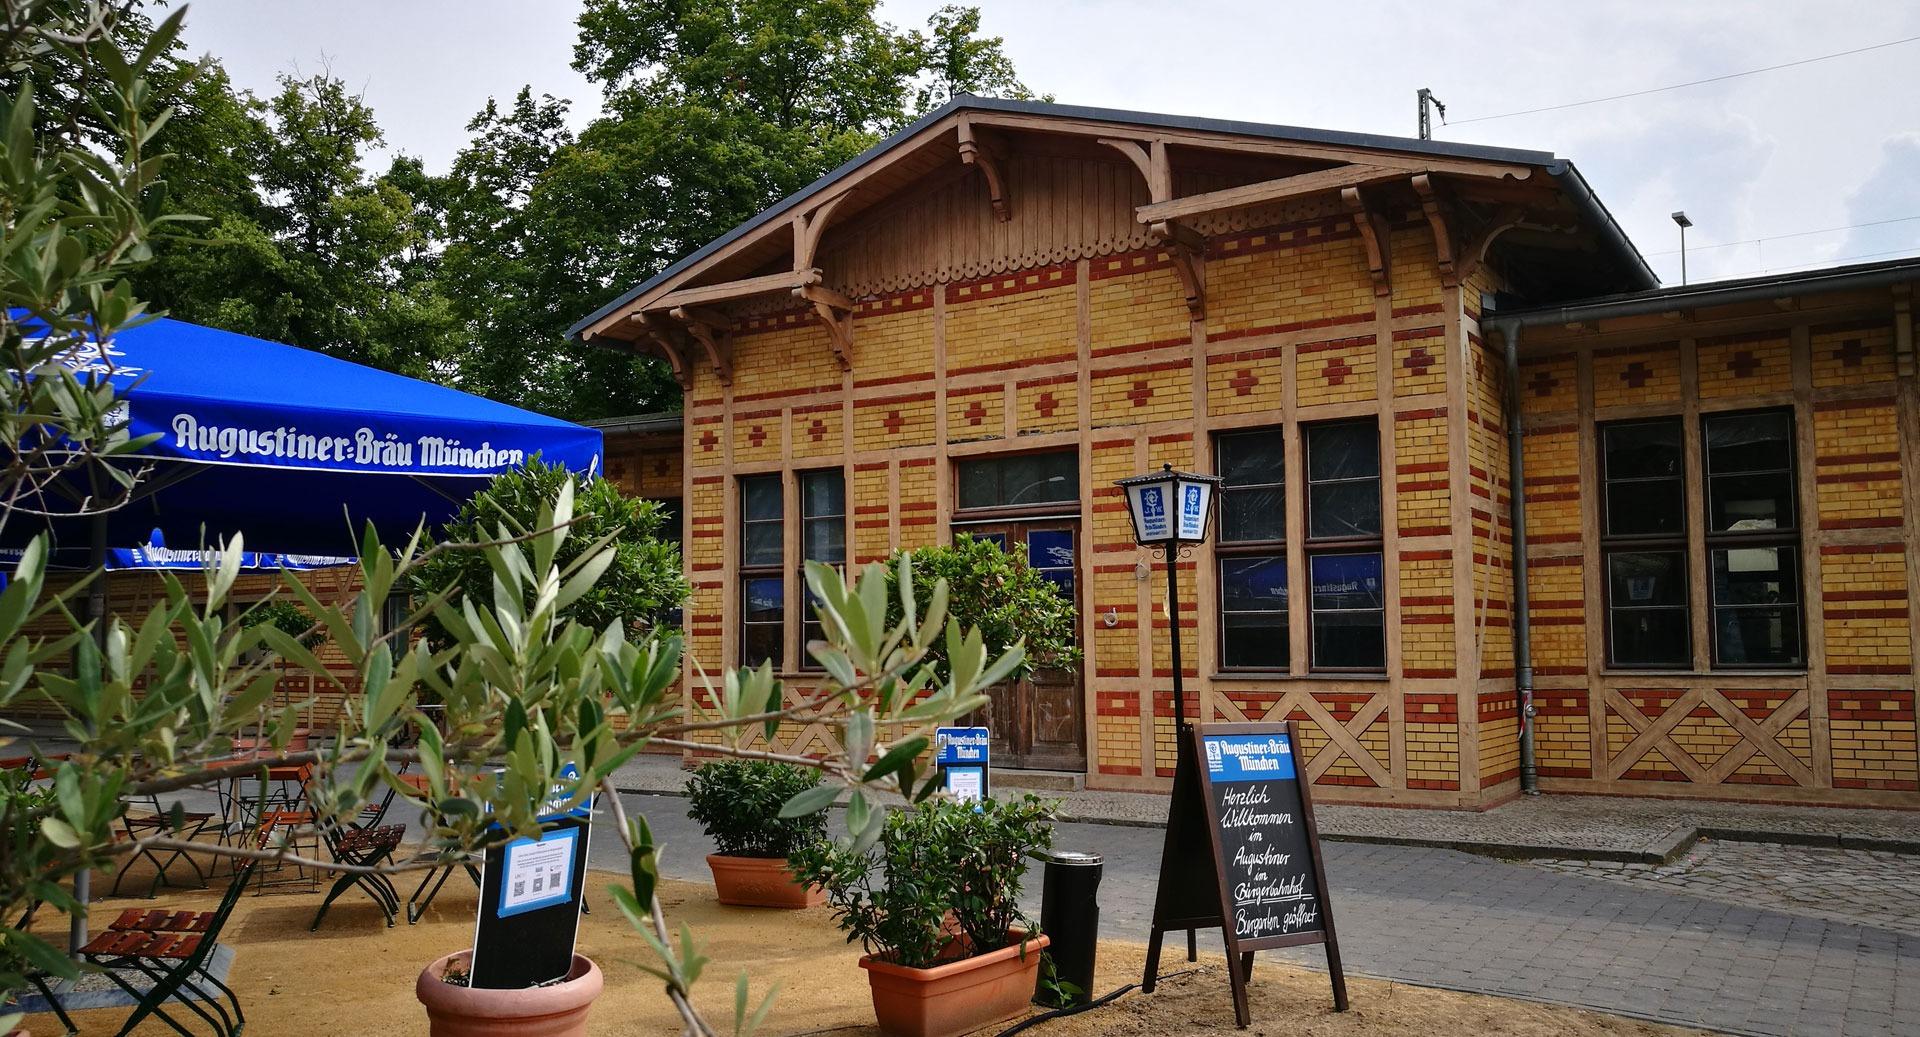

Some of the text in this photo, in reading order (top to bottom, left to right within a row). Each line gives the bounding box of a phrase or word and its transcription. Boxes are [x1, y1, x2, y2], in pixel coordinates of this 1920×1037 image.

[418, 435, 524, 469] München
[1238, 755, 1280, 772] München
[1222, 784, 1271, 807] Herzlich
[1220, 807, 1294, 829] Willkommen
[1248, 828, 1263, 842] im
[1232, 843, 1291, 876] Augustiner
[1253, 867, 1268, 881] im
[1234, 873, 1306, 906] Bürgerbahnhof
[1235, 903, 1318, 938] Biergarten geöffnet
